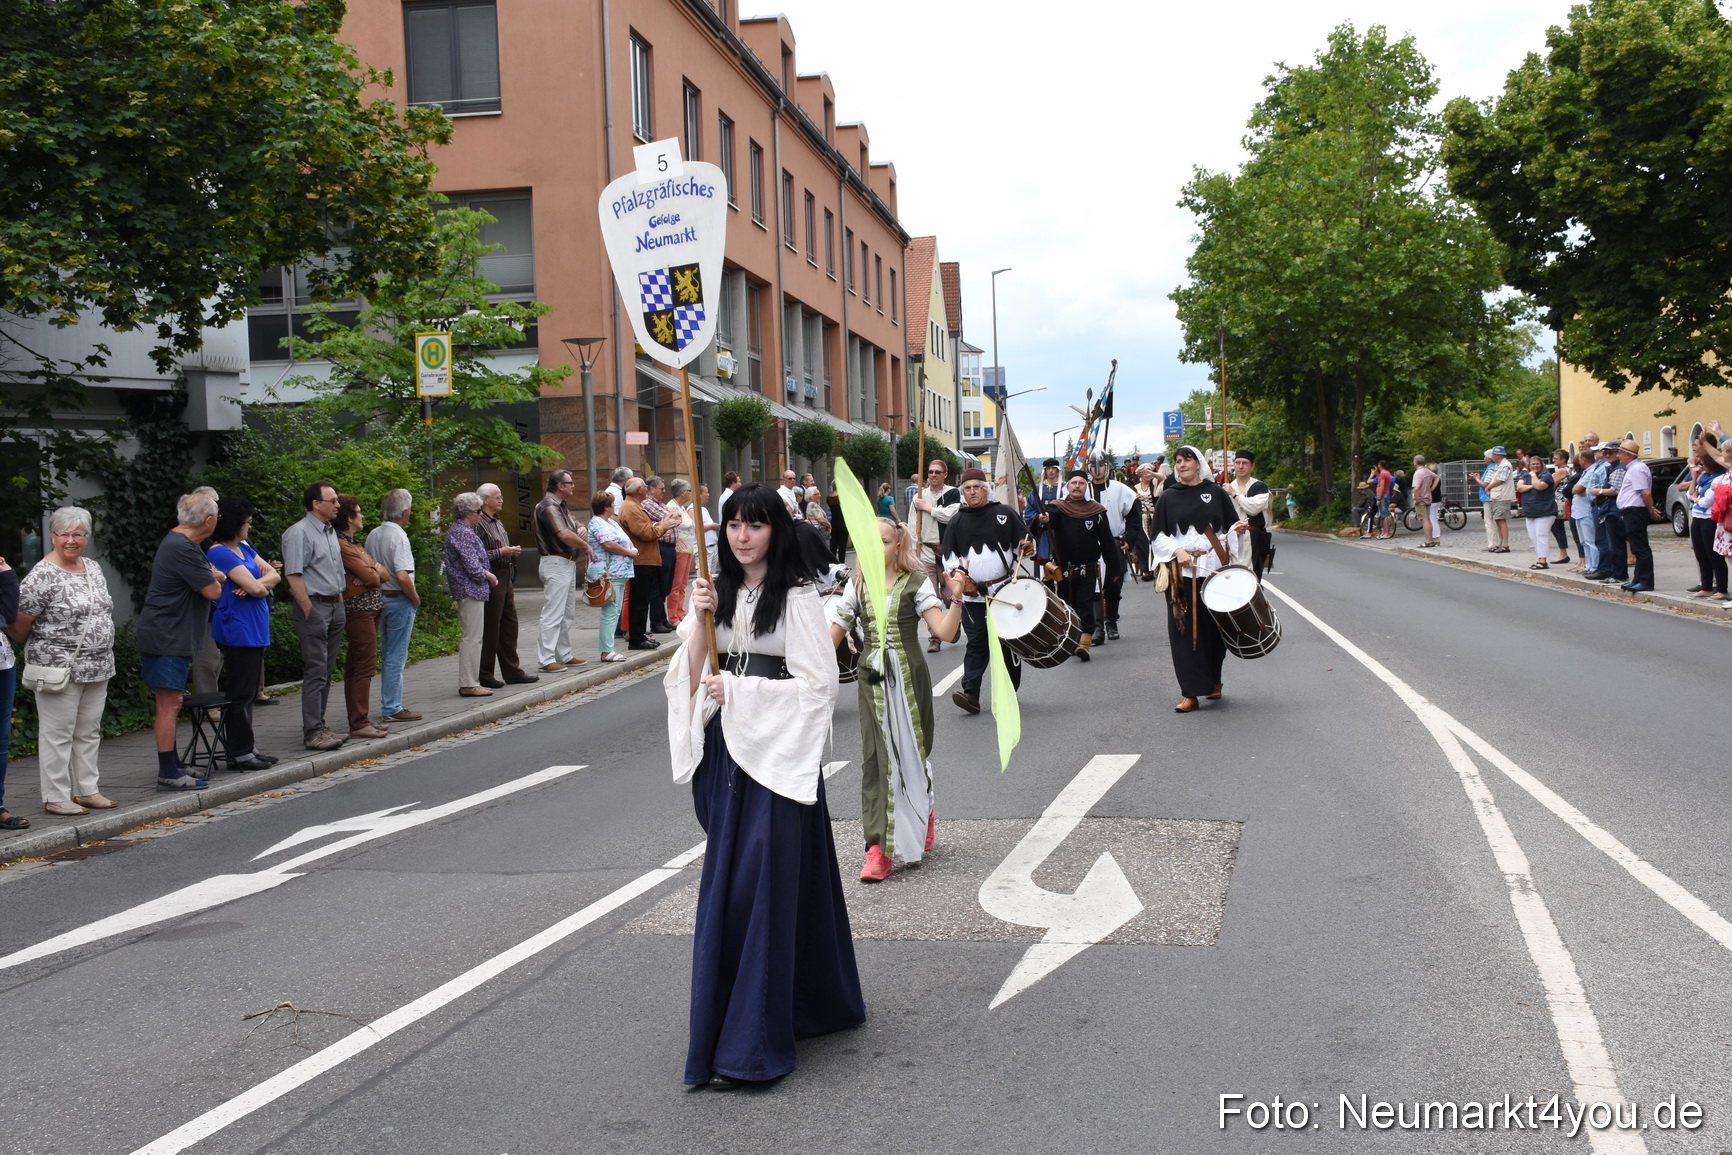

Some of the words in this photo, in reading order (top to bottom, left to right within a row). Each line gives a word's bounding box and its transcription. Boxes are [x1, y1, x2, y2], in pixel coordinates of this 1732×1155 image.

[657, 153, 668, 172] 5
[612, 176, 715, 219] Pfalzgräfisches
[648, 213, 681, 229] Gefolge
[635, 227, 698, 253] Neumarkt
[427, 345, 440, 362] H
[1169, 416, 1177, 426] P
